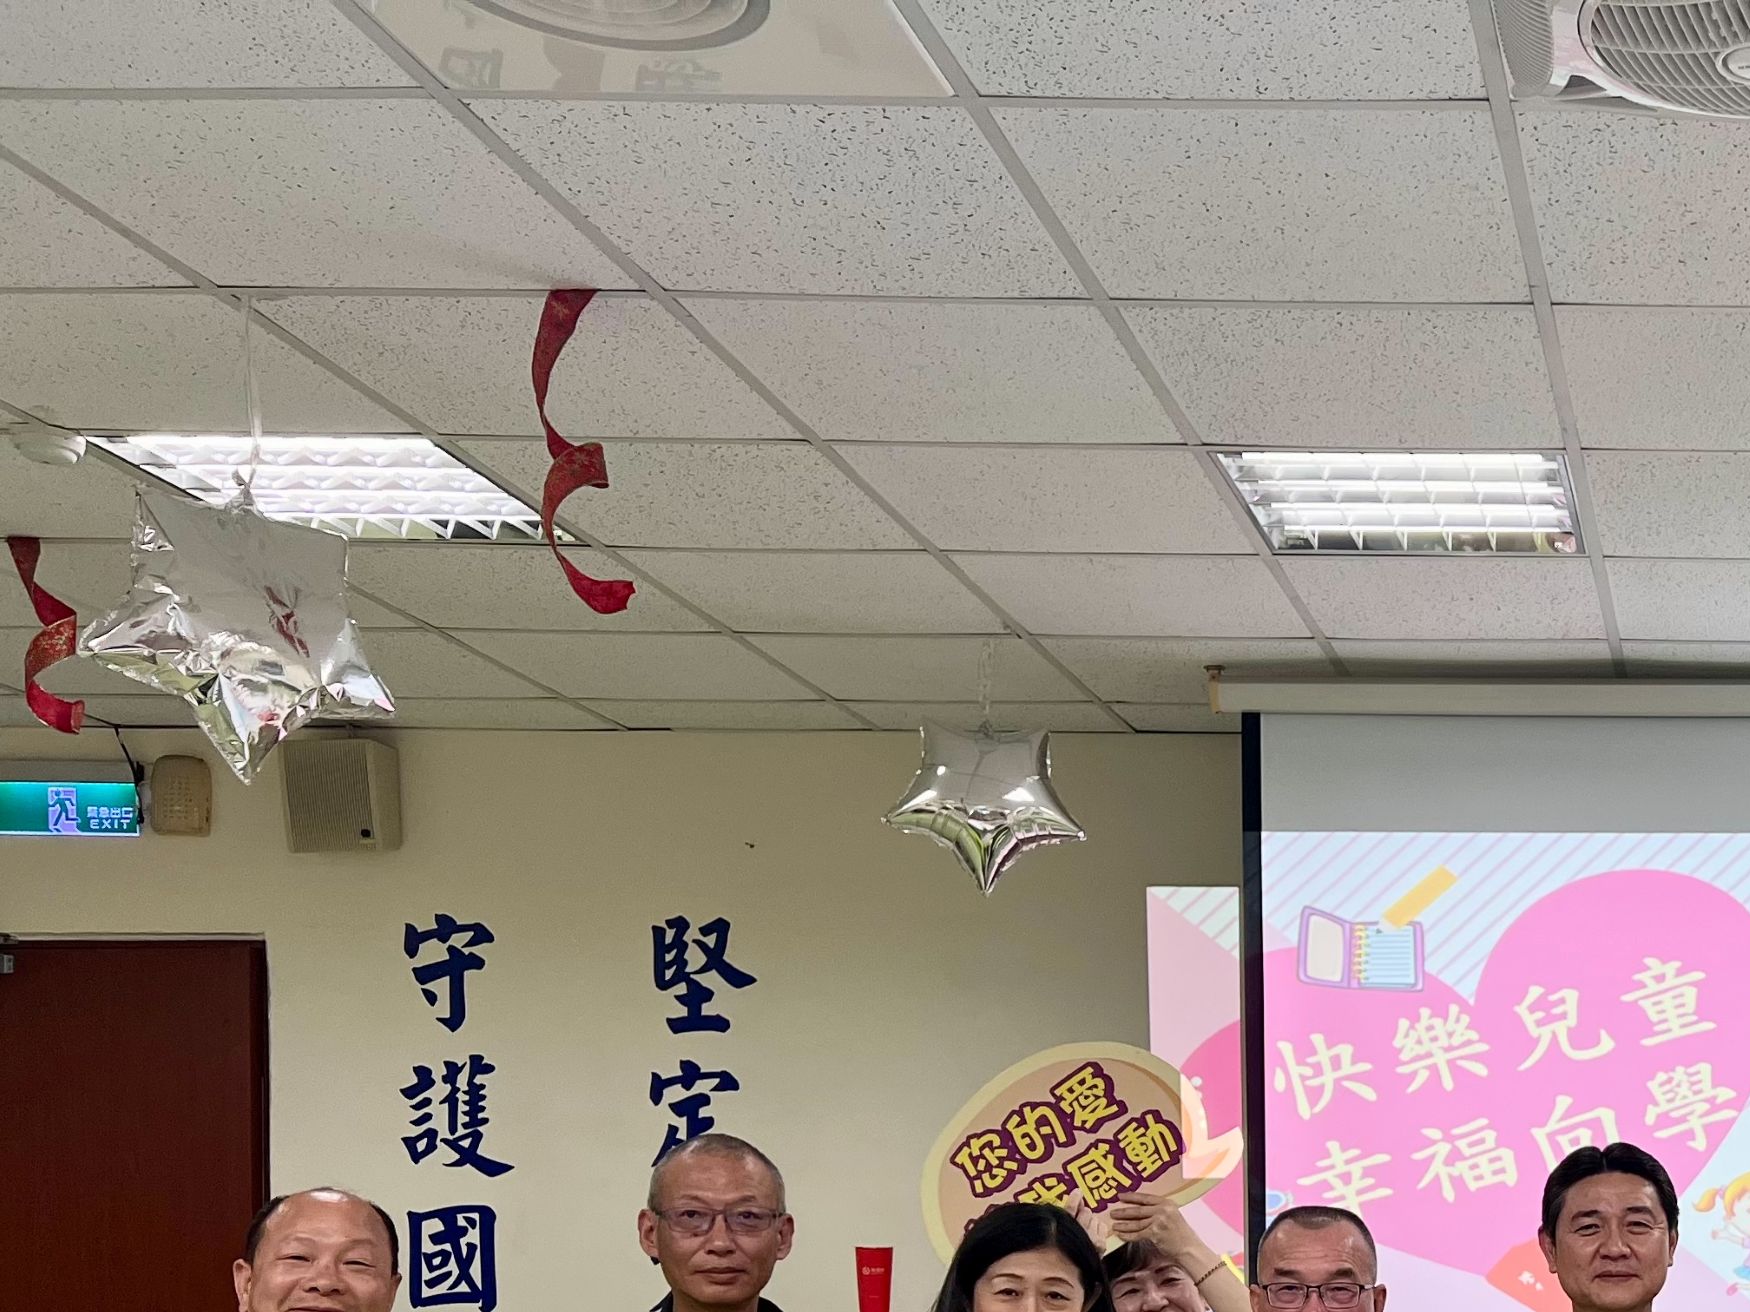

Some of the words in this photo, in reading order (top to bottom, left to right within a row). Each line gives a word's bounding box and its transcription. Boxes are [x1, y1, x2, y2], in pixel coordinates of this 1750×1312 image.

[89, 818, 131, 830] EXIT
[1274, 956, 1717, 1120] 快樂兒童
[951, 1062, 1124, 1196] 您的愛
